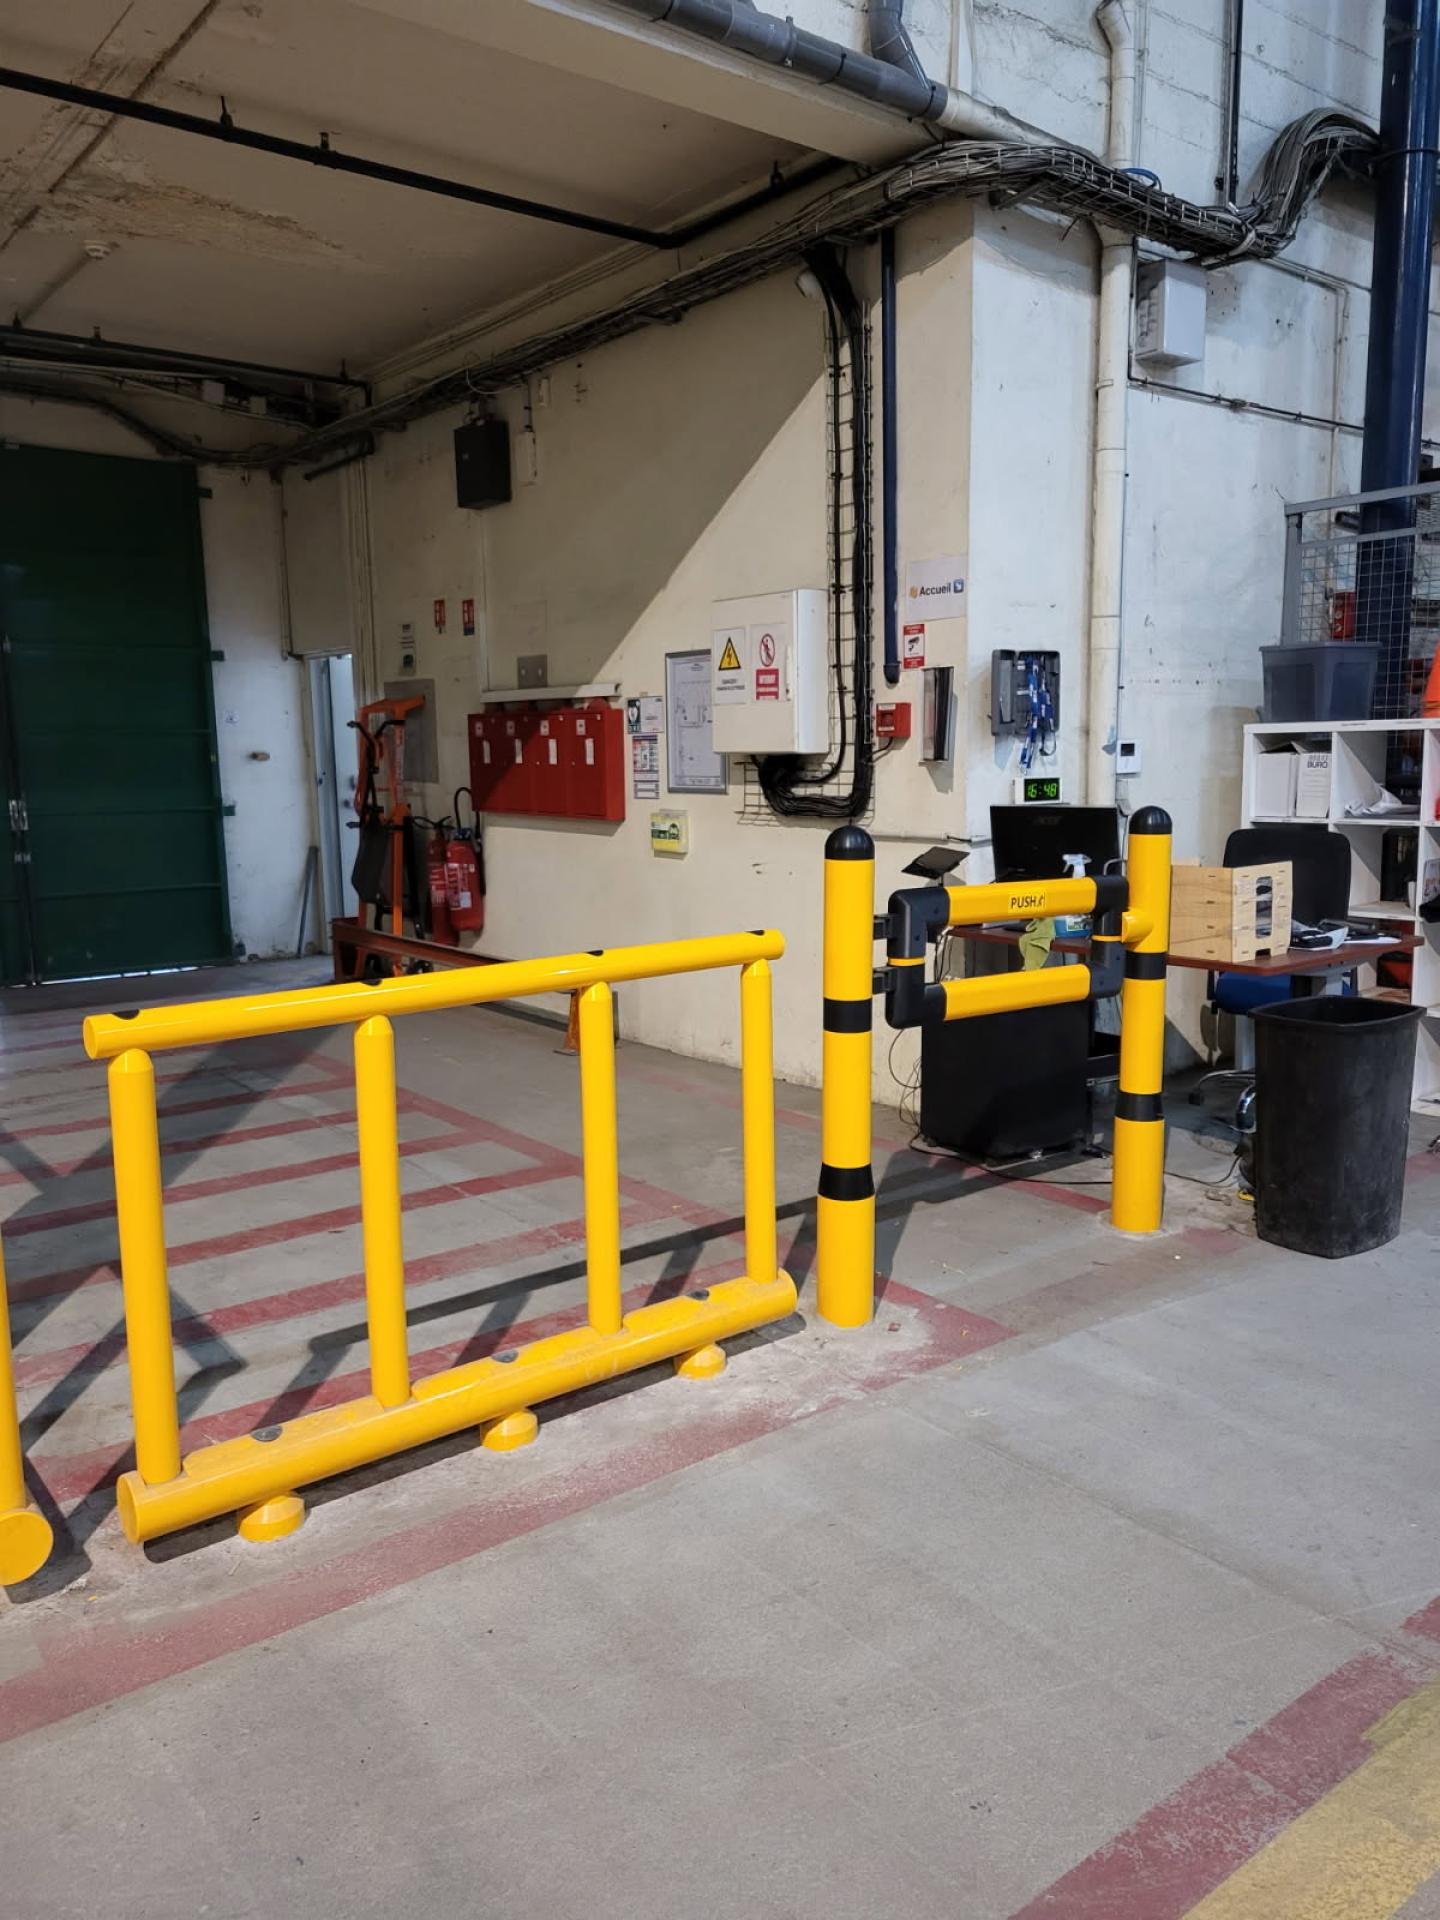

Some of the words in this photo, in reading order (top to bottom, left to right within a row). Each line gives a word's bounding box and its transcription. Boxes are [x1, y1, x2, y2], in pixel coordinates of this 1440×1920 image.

[919, 583, 951, 596] Accueil
[1027, 783, 1057, 798] 16:48
[1011, 895, 1037, 909] PUSH
